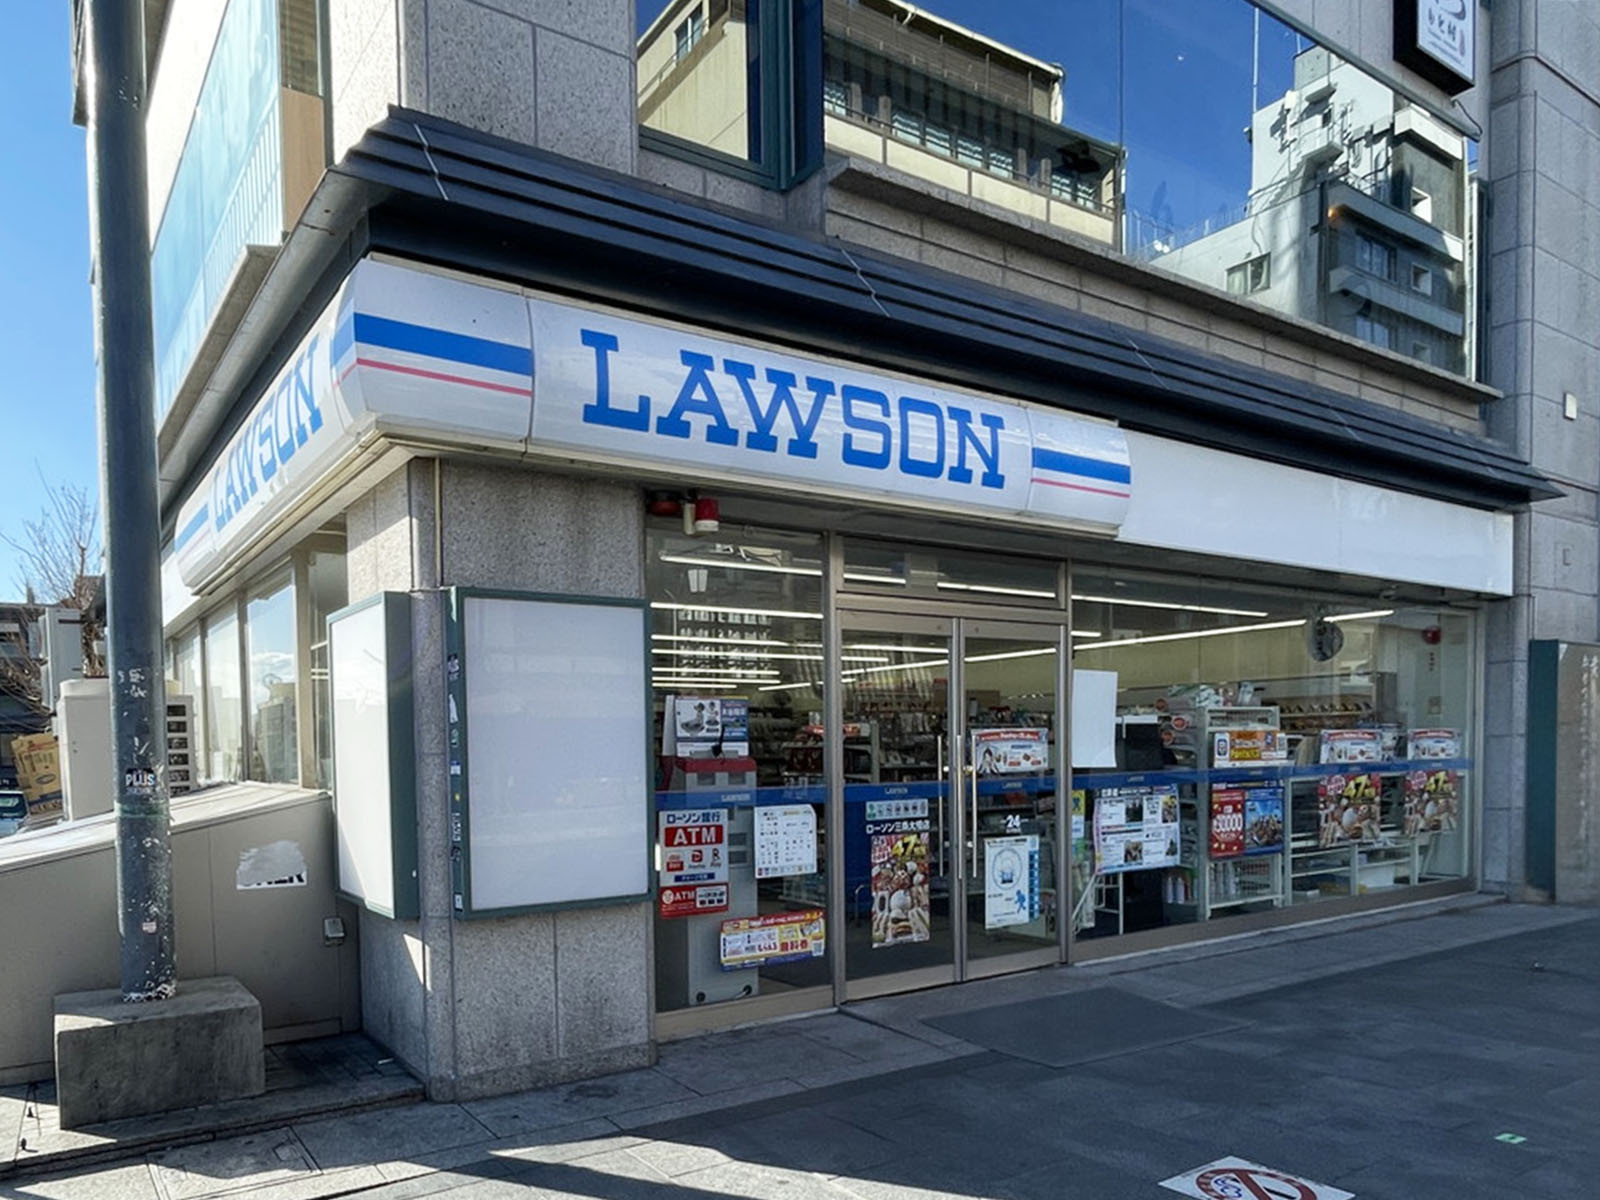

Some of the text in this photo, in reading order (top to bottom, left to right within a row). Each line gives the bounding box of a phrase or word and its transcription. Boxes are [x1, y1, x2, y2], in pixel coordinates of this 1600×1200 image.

[580, 328, 1005, 489] LAWSON
[210, 333, 324, 533] LAWSON
[666, 811, 721, 824] ローソン銀行
[1006, 814, 1021, 828] 24
[672, 826, 717, 846] ATM
[673, 890, 696, 901] ATM
